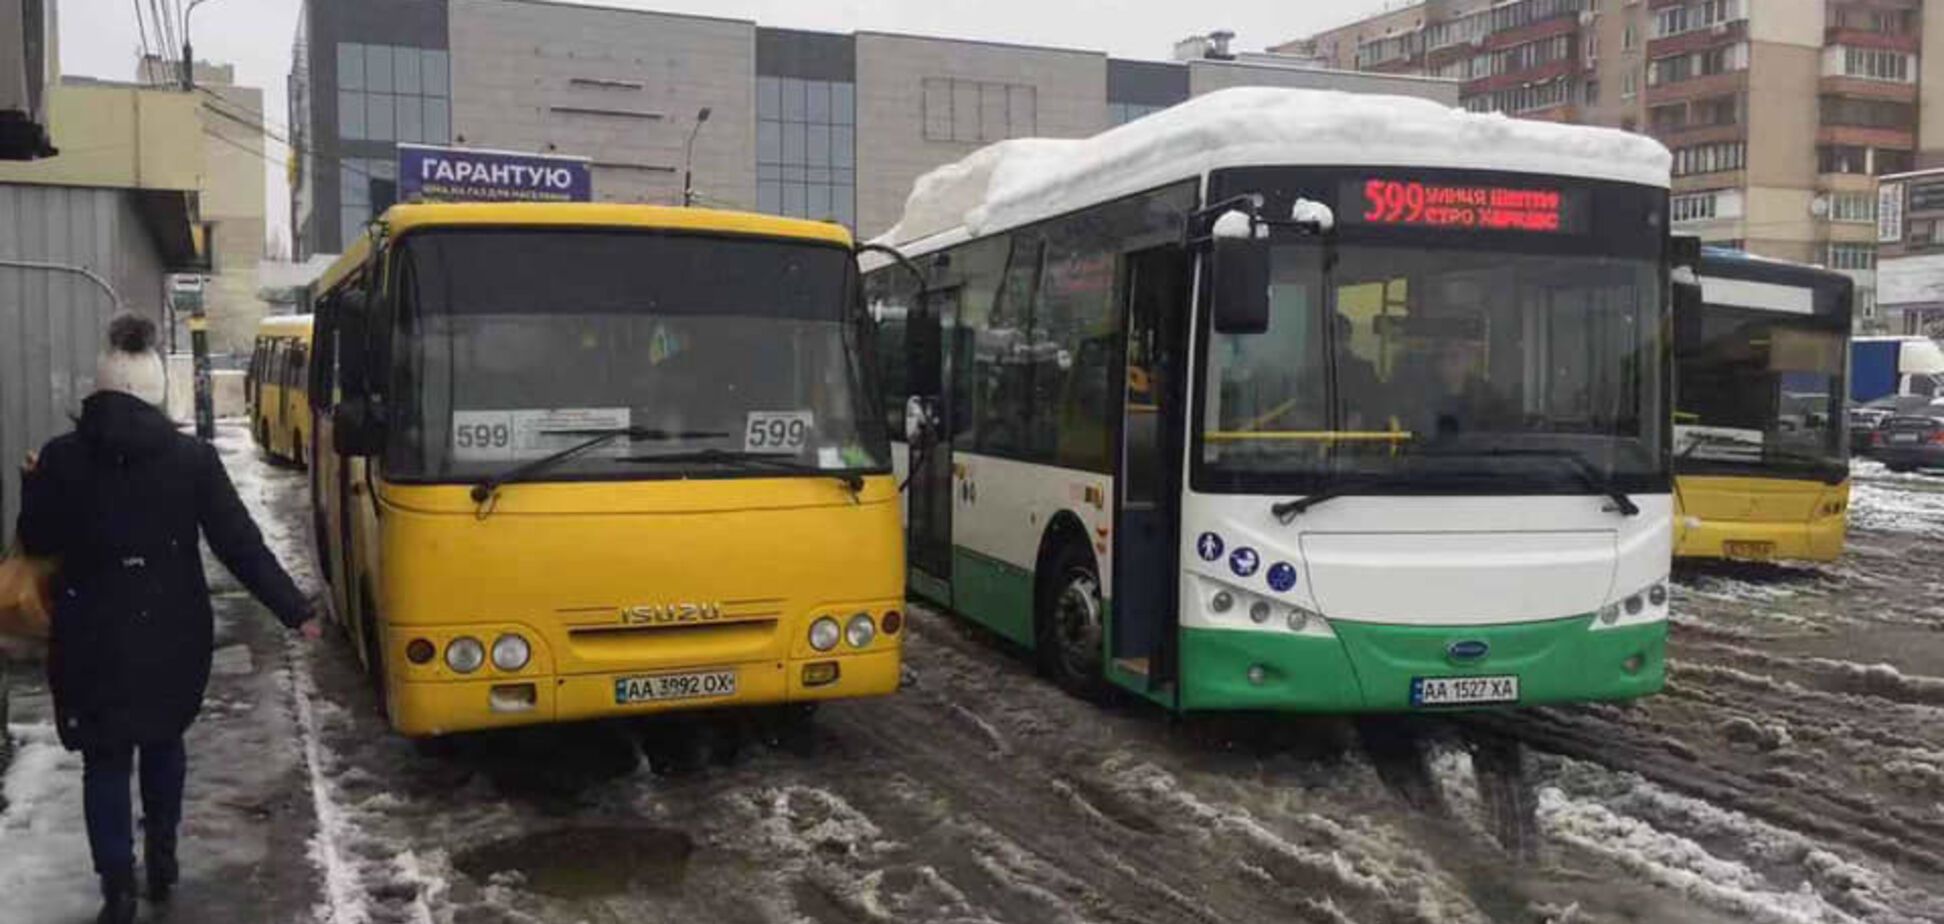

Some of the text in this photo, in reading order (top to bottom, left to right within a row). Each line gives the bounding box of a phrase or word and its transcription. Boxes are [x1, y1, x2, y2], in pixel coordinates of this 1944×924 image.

[422, 158, 571, 189] ГАРАНТУЮ
[1364, 178, 1425, 222] 599
[457, 424, 508, 448] 599
[750, 419, 805, 447] 599
[621, 602, 720, 625] ISUZU
[629, 680, 653, 699] AA
[1425, 679, 1513, 699] AA 1527 XA
